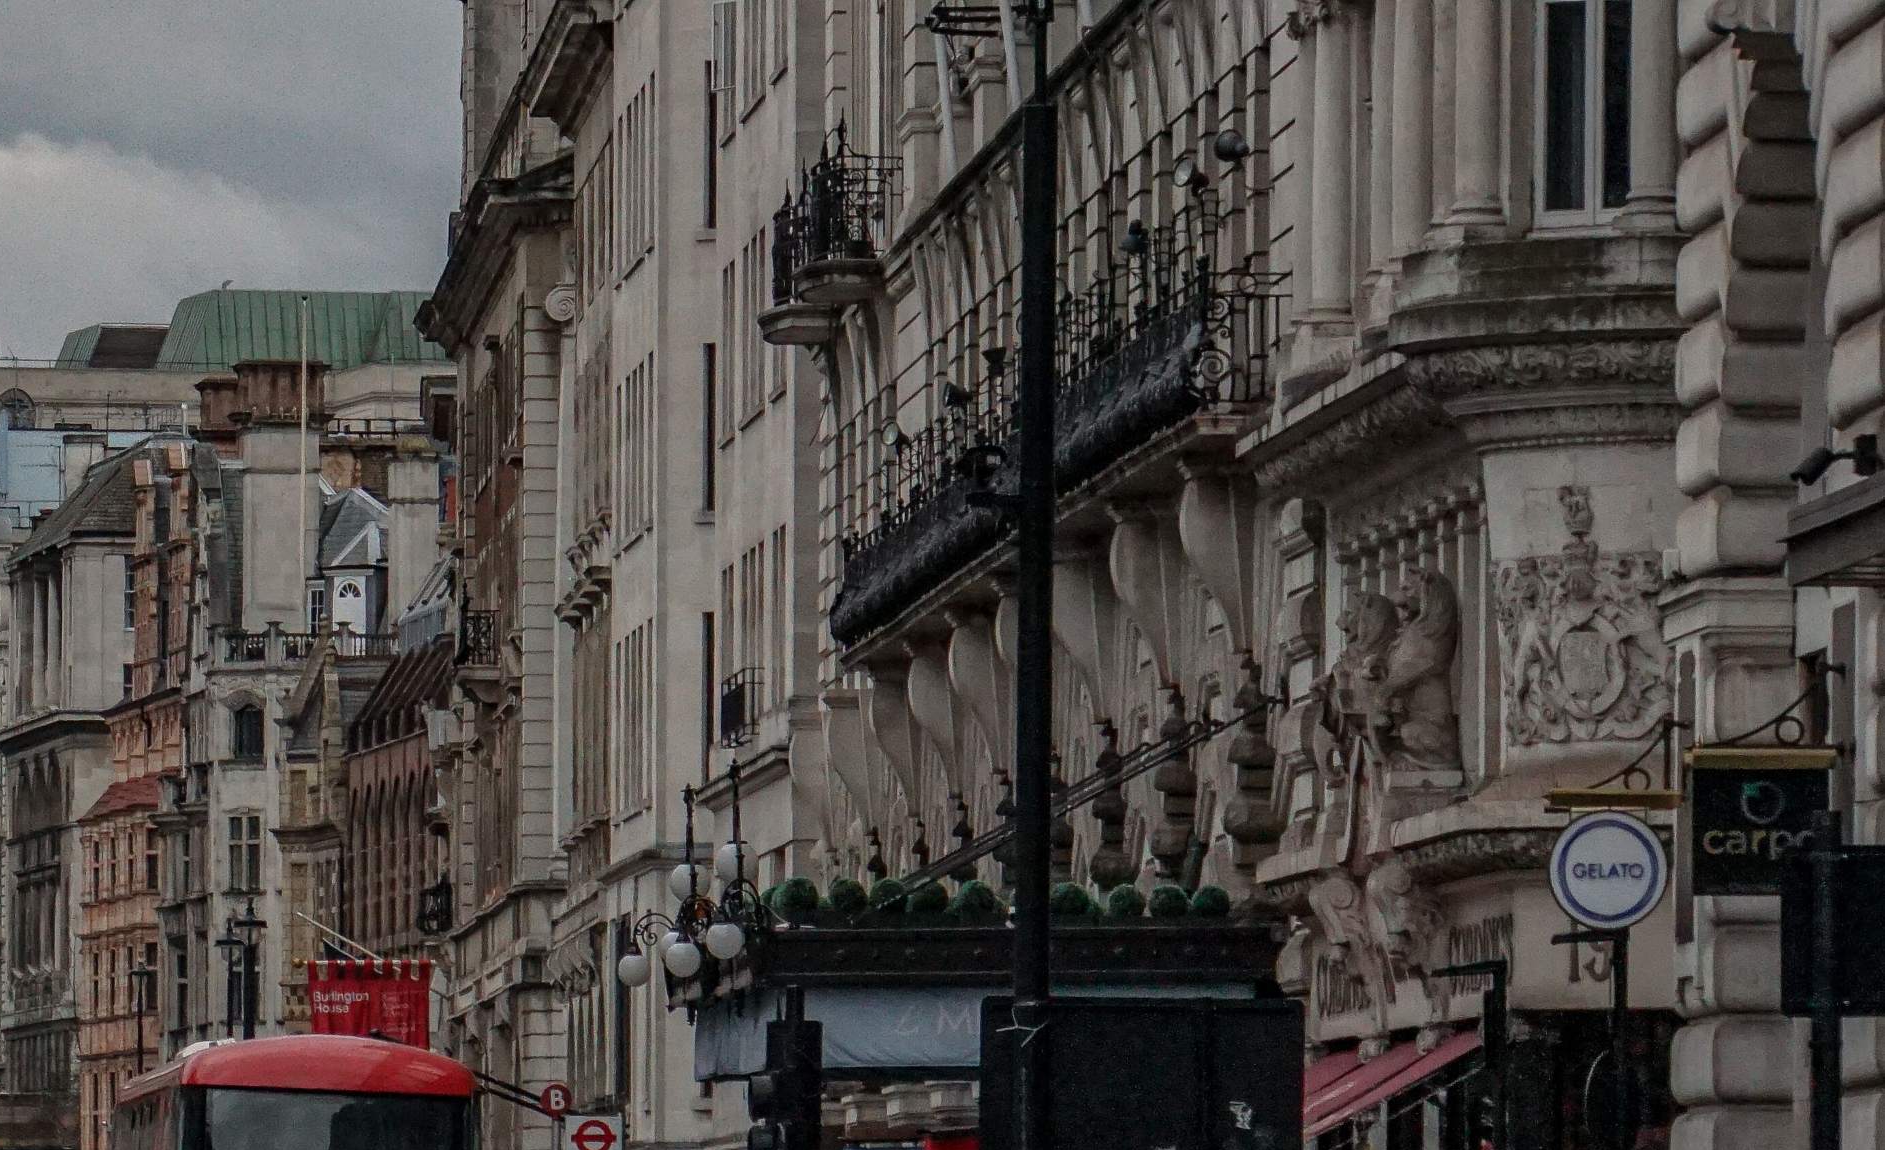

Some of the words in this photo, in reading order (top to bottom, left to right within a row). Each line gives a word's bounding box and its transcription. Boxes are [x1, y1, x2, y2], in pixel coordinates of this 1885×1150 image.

[1573, 863, 1644, 879] GELATO
[313, 991, 370, 1004] Burlington
[314, 1003, 349, 1014] House
[550, 1089, 565, 1110] B
